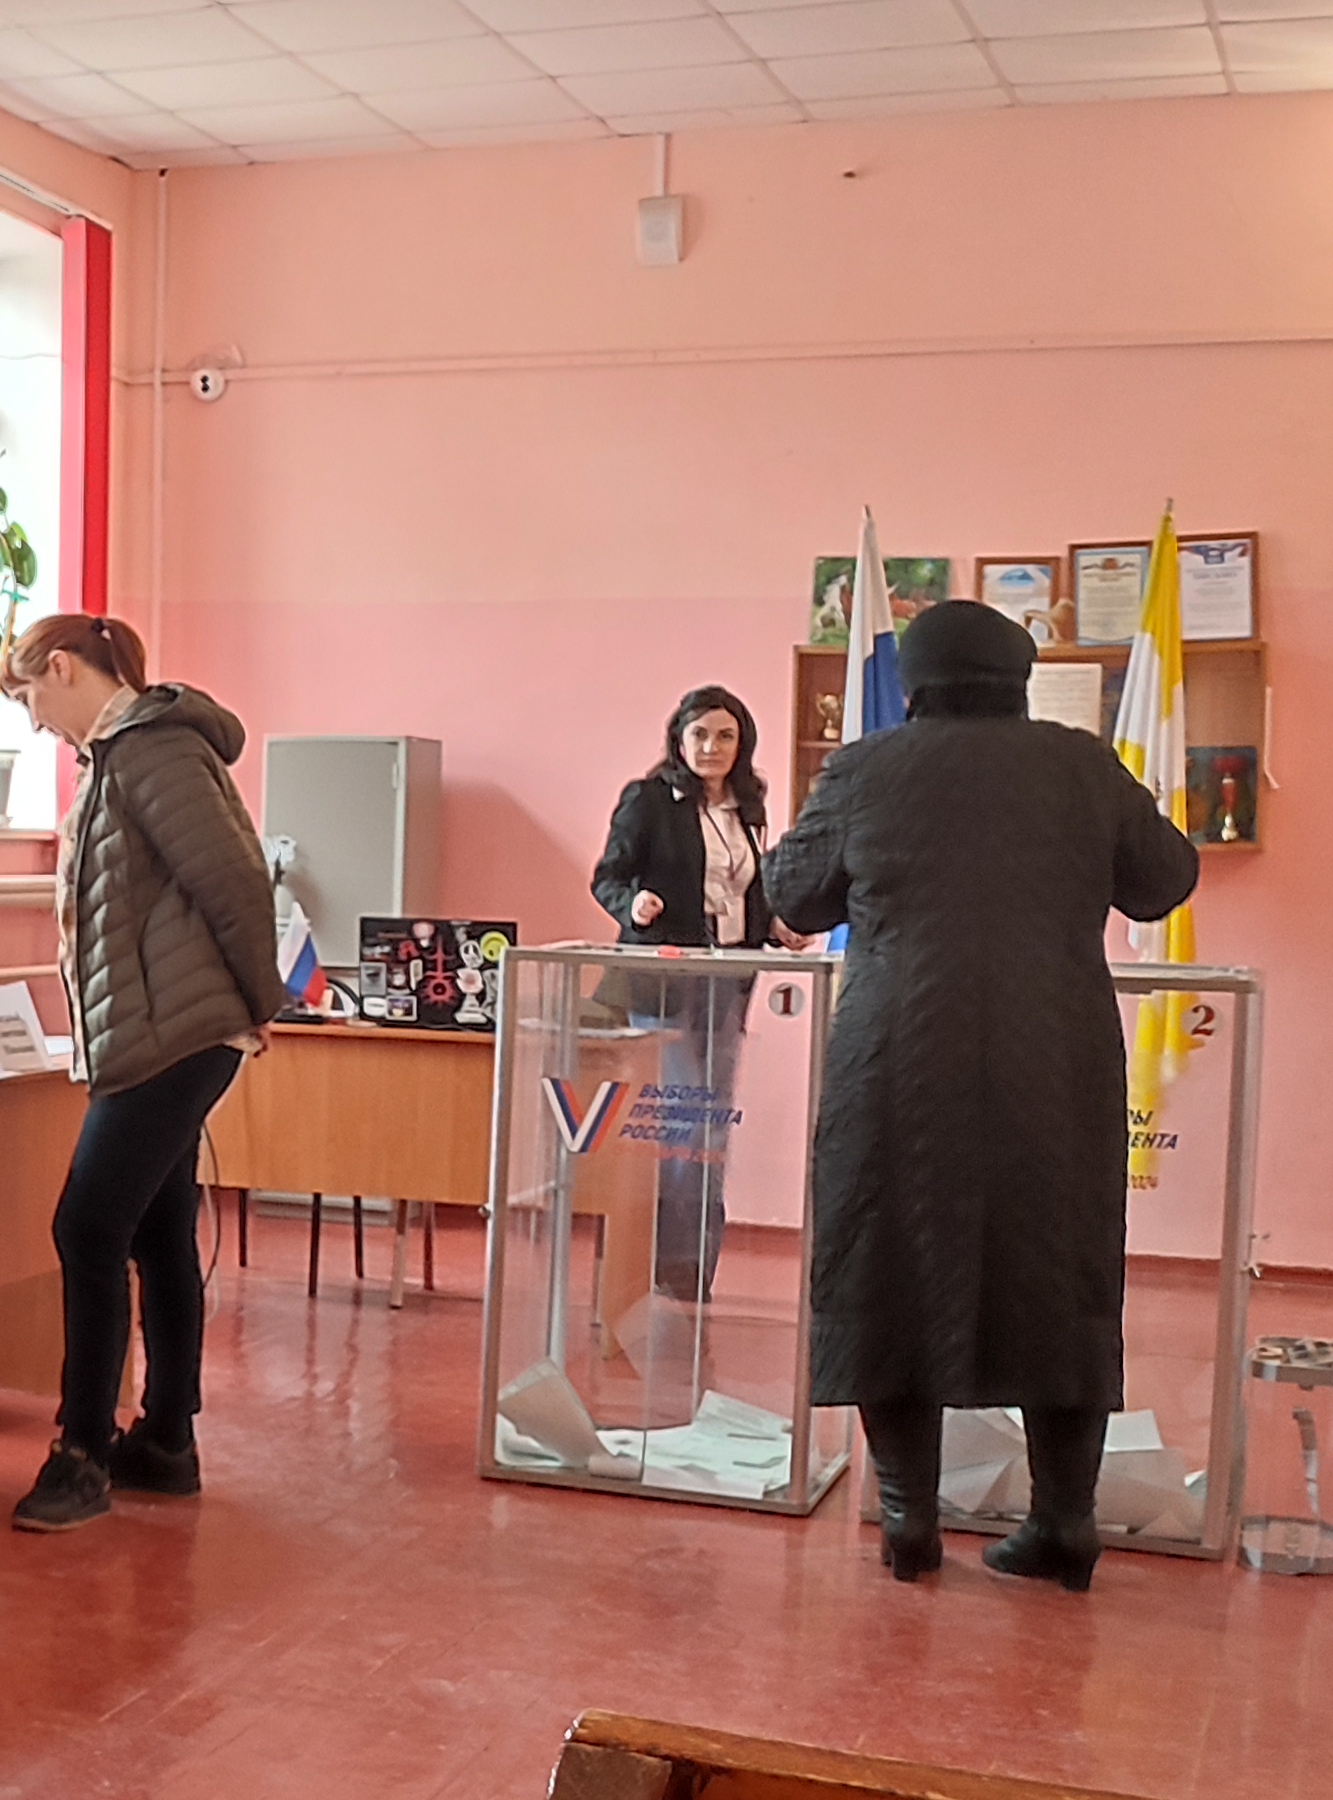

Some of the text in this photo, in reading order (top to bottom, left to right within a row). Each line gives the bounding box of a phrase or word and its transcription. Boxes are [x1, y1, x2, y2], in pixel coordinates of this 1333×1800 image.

[775, 986, 794, 1016] 1
[1190, 1004, 1216, 1037] 2
[639, 1083, 722, 1102] ВЫБОРЫ
[629, 1103, 744, 1126] ПРЕЗИДЕНТА
[618, 1123, 693, 1142] РОССИИ
